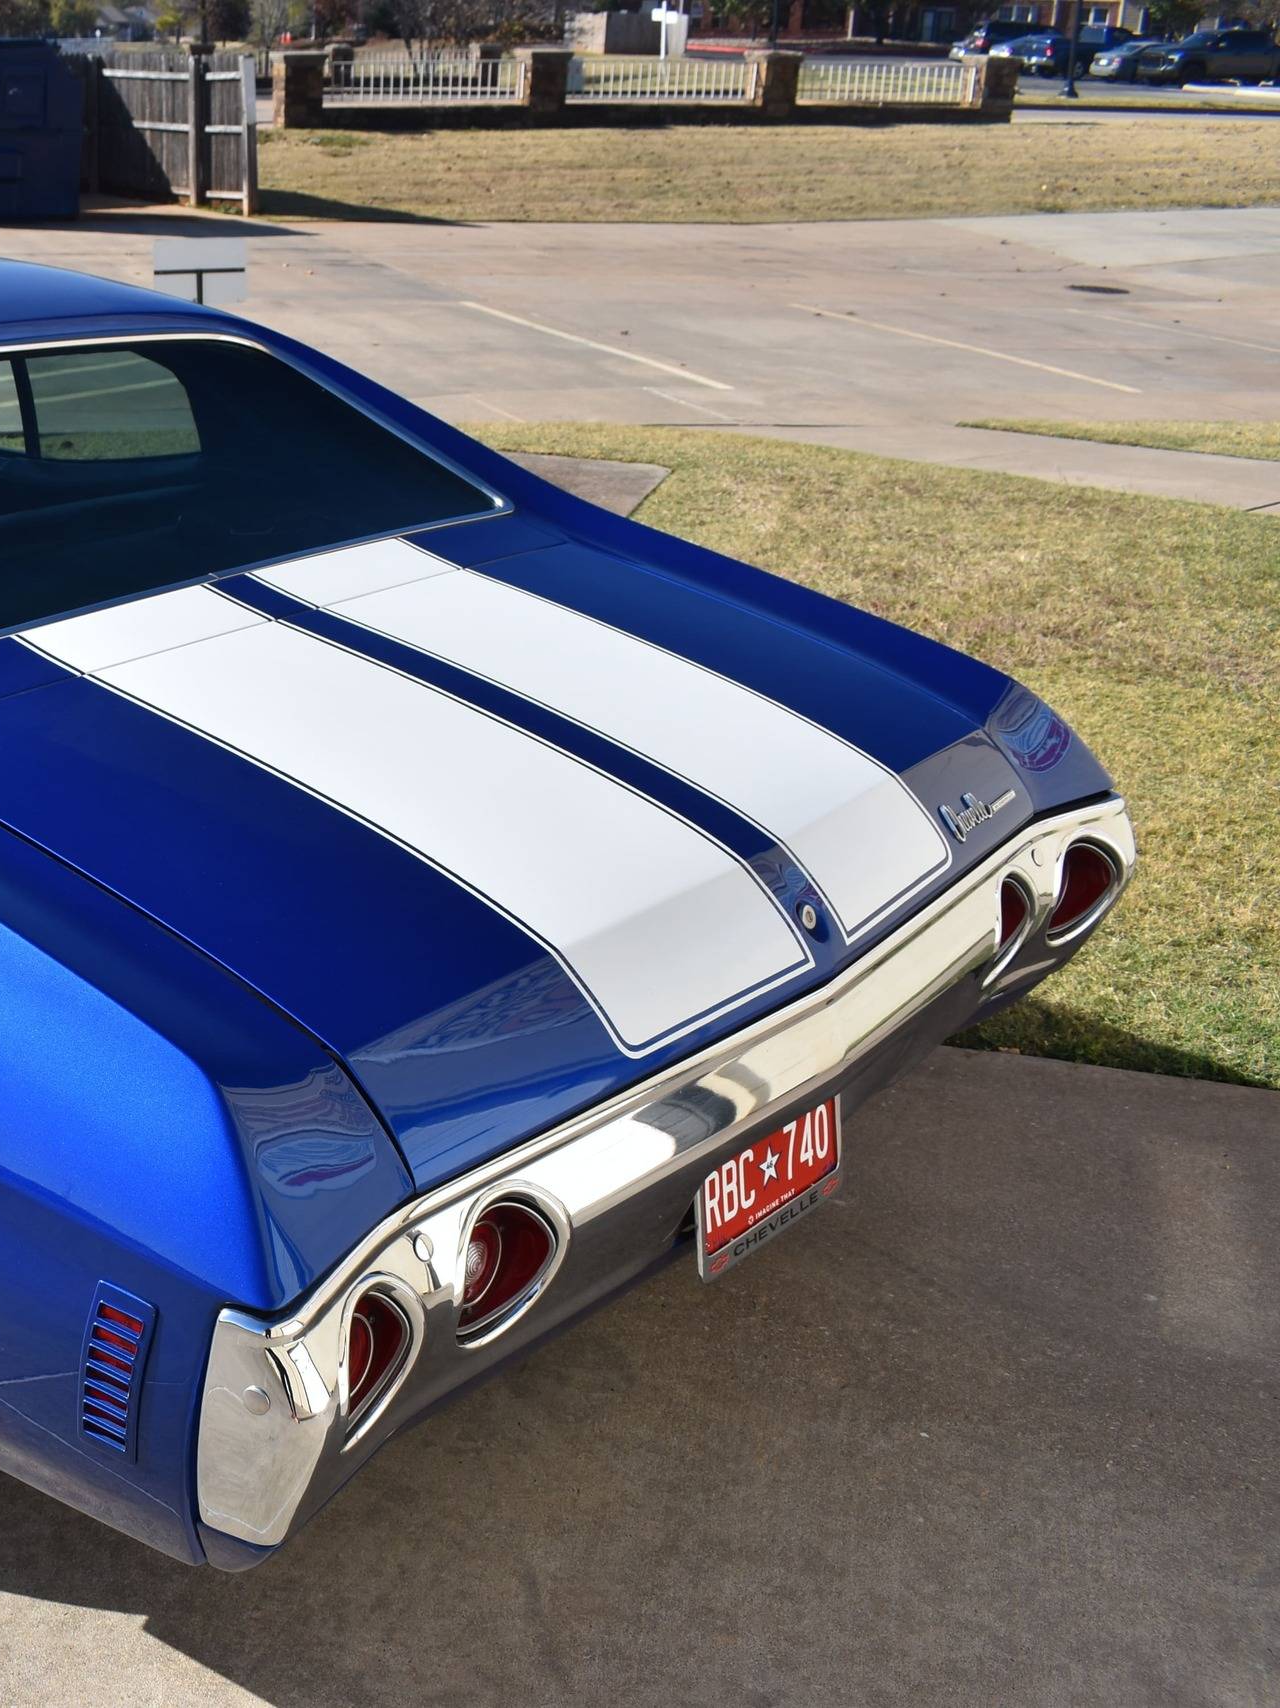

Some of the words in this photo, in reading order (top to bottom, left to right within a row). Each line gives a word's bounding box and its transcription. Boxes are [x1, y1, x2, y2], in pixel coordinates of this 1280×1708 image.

[705, 1149, 756, 1234] RBC
[783, 1104, 829, 1181] 740
[733, 1190, 819, 1257] CHEVELLE
[755, 1198, 780, 1220] IMAGINE
[780, 1188, 795, 1203] THAT
